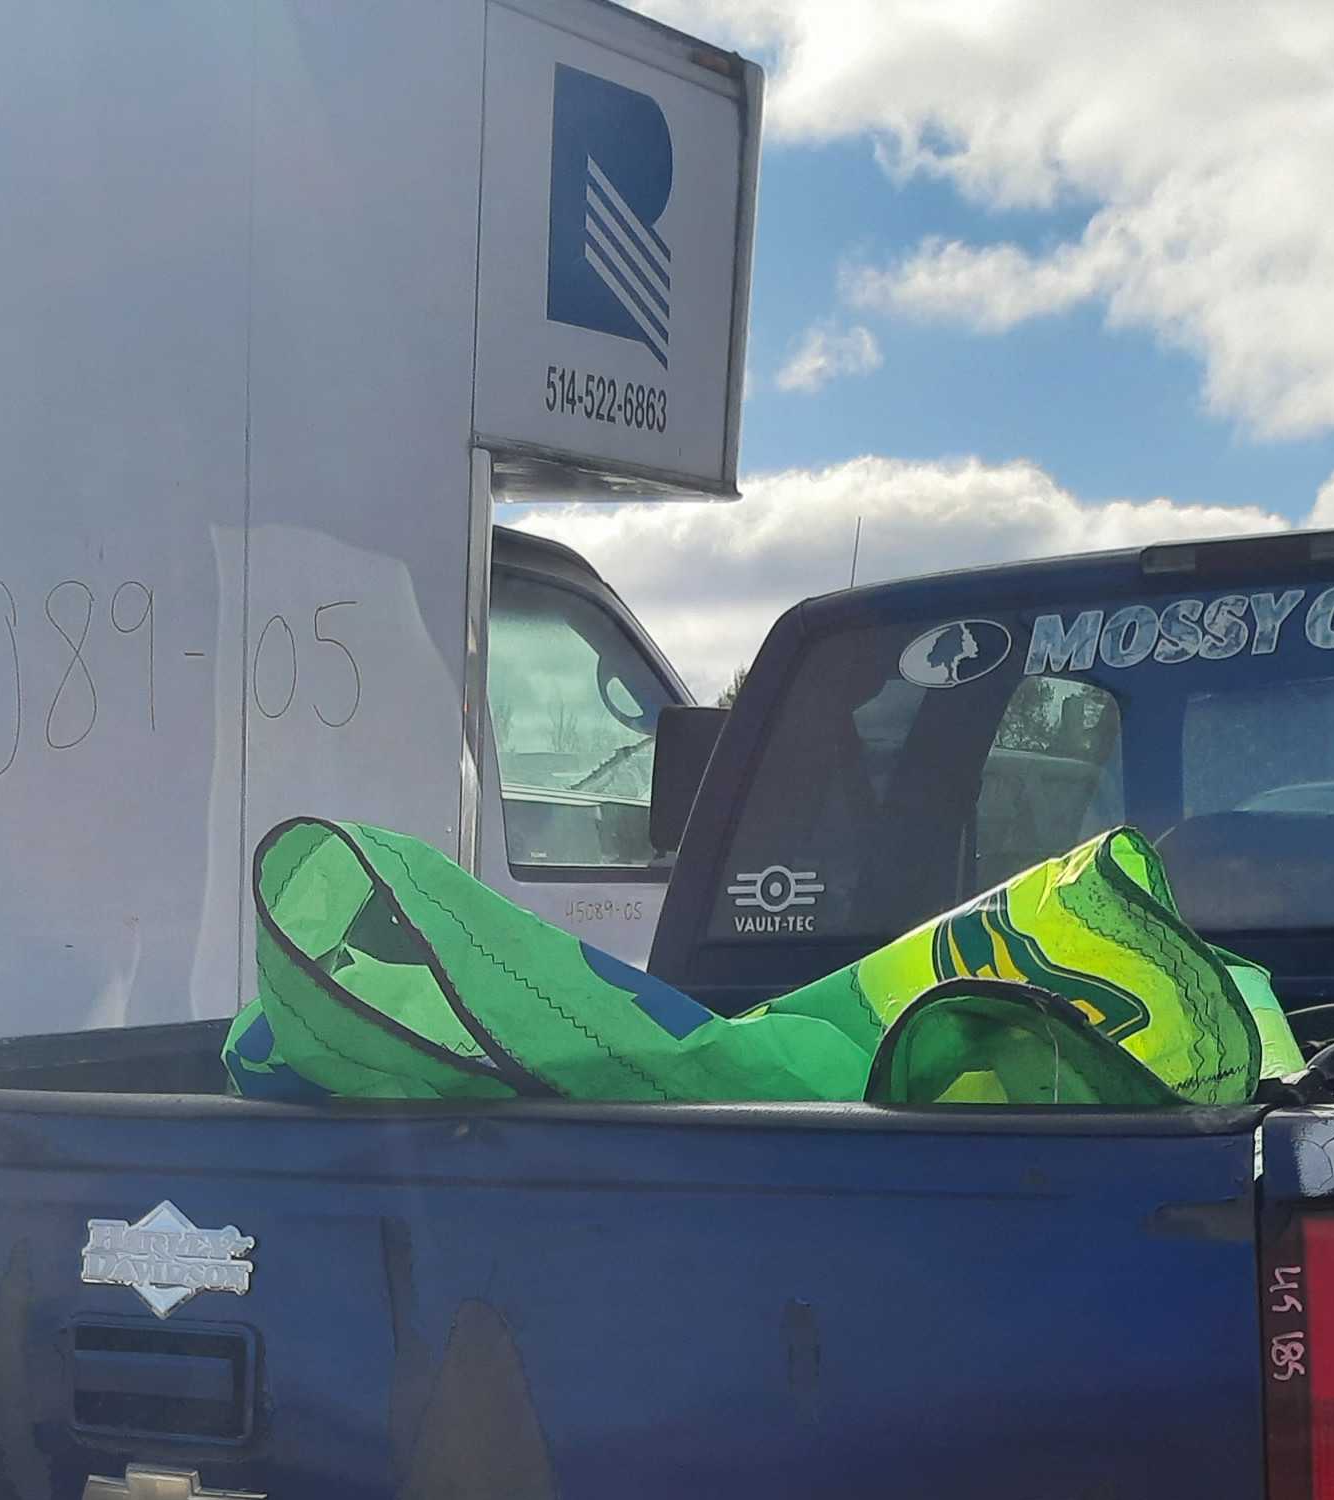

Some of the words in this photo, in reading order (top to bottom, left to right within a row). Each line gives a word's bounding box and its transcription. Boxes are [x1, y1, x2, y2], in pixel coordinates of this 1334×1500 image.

[546, 366, 667, 432] 514-522-6863
[1024, 589, 1305, 675] MOSSY
[734, 916, 814, 932] VAULT-TEC
[1269, 1266, 1301, 1312] 45
[1271, 1331, 1305, 1380] 185
